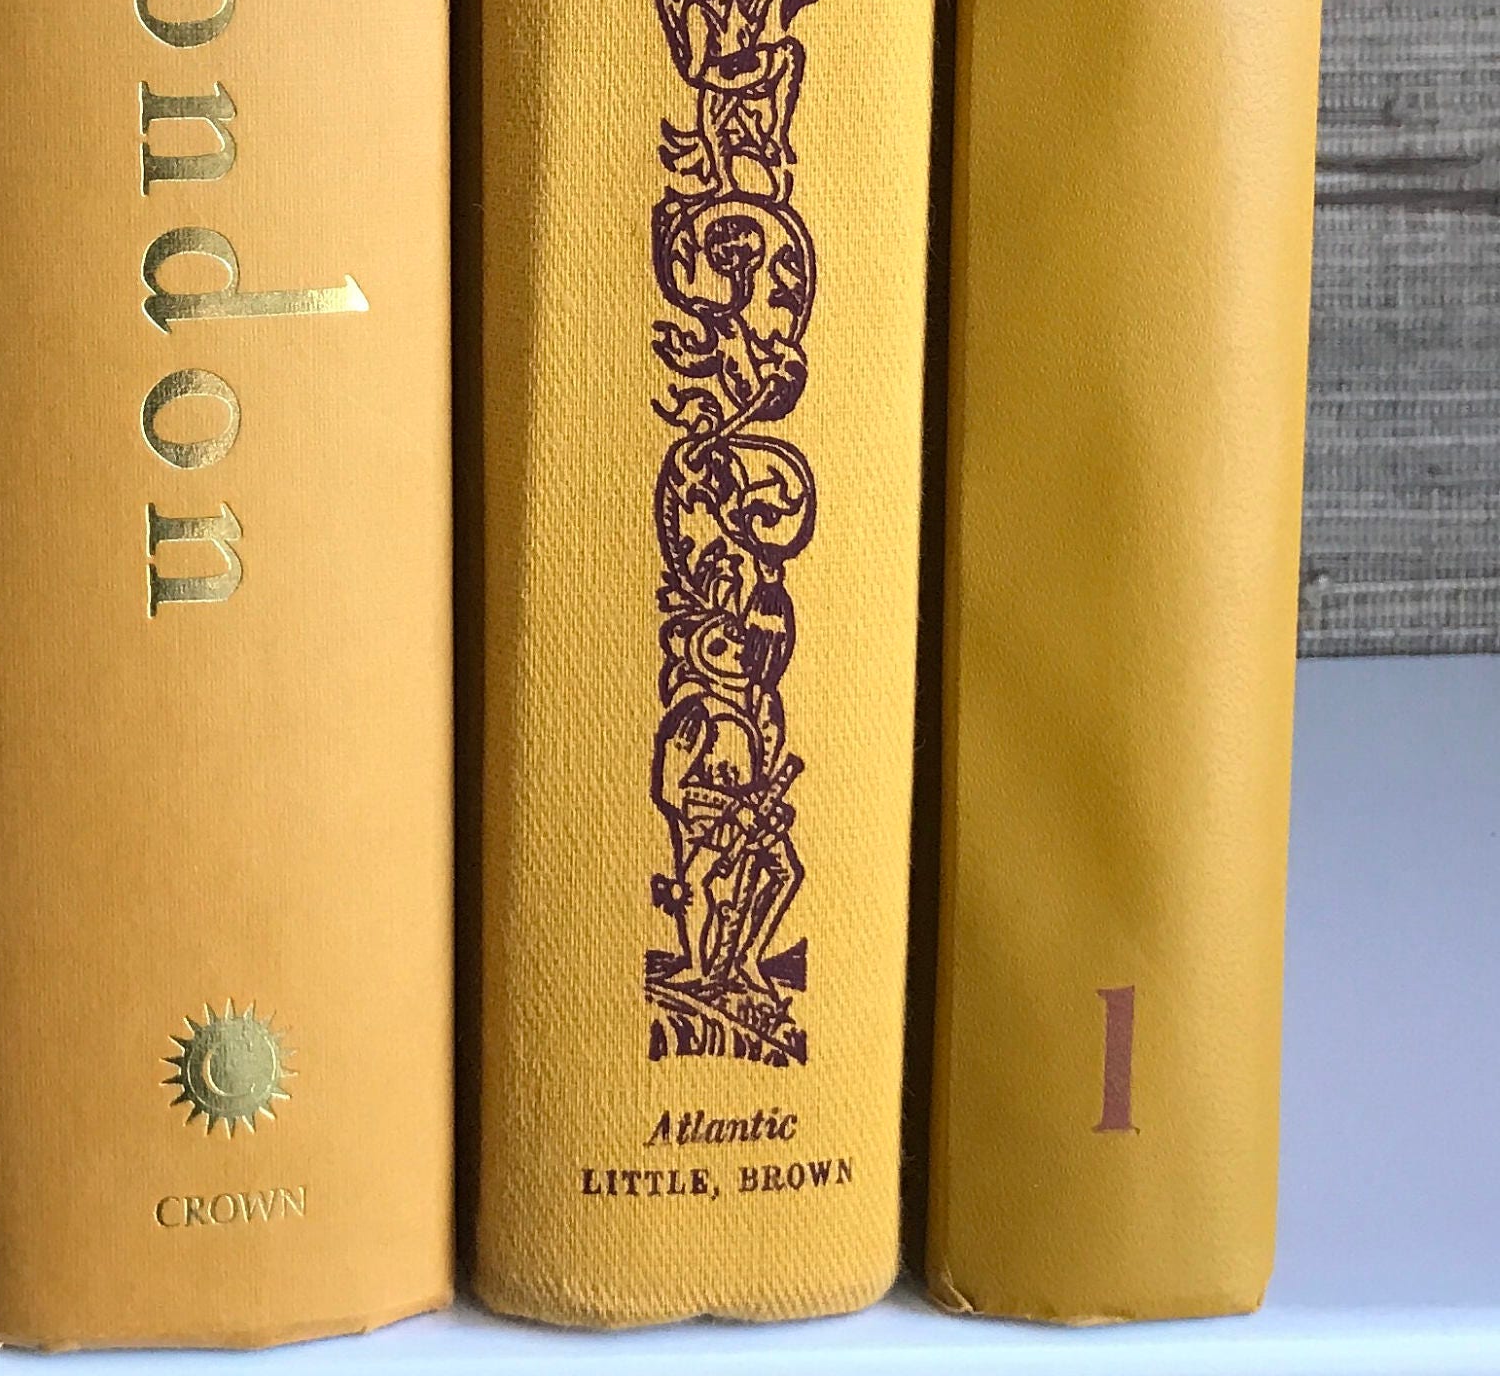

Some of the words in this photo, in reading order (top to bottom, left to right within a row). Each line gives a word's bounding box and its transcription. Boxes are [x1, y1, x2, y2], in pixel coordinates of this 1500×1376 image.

[643, 1106, 799, 1147] Atlantic
[580, 1168, 720, 1200] LITTLE,
[738, 1157, 853, 1194] BROWN
[152, 1186, 307, 1228] CROWN
